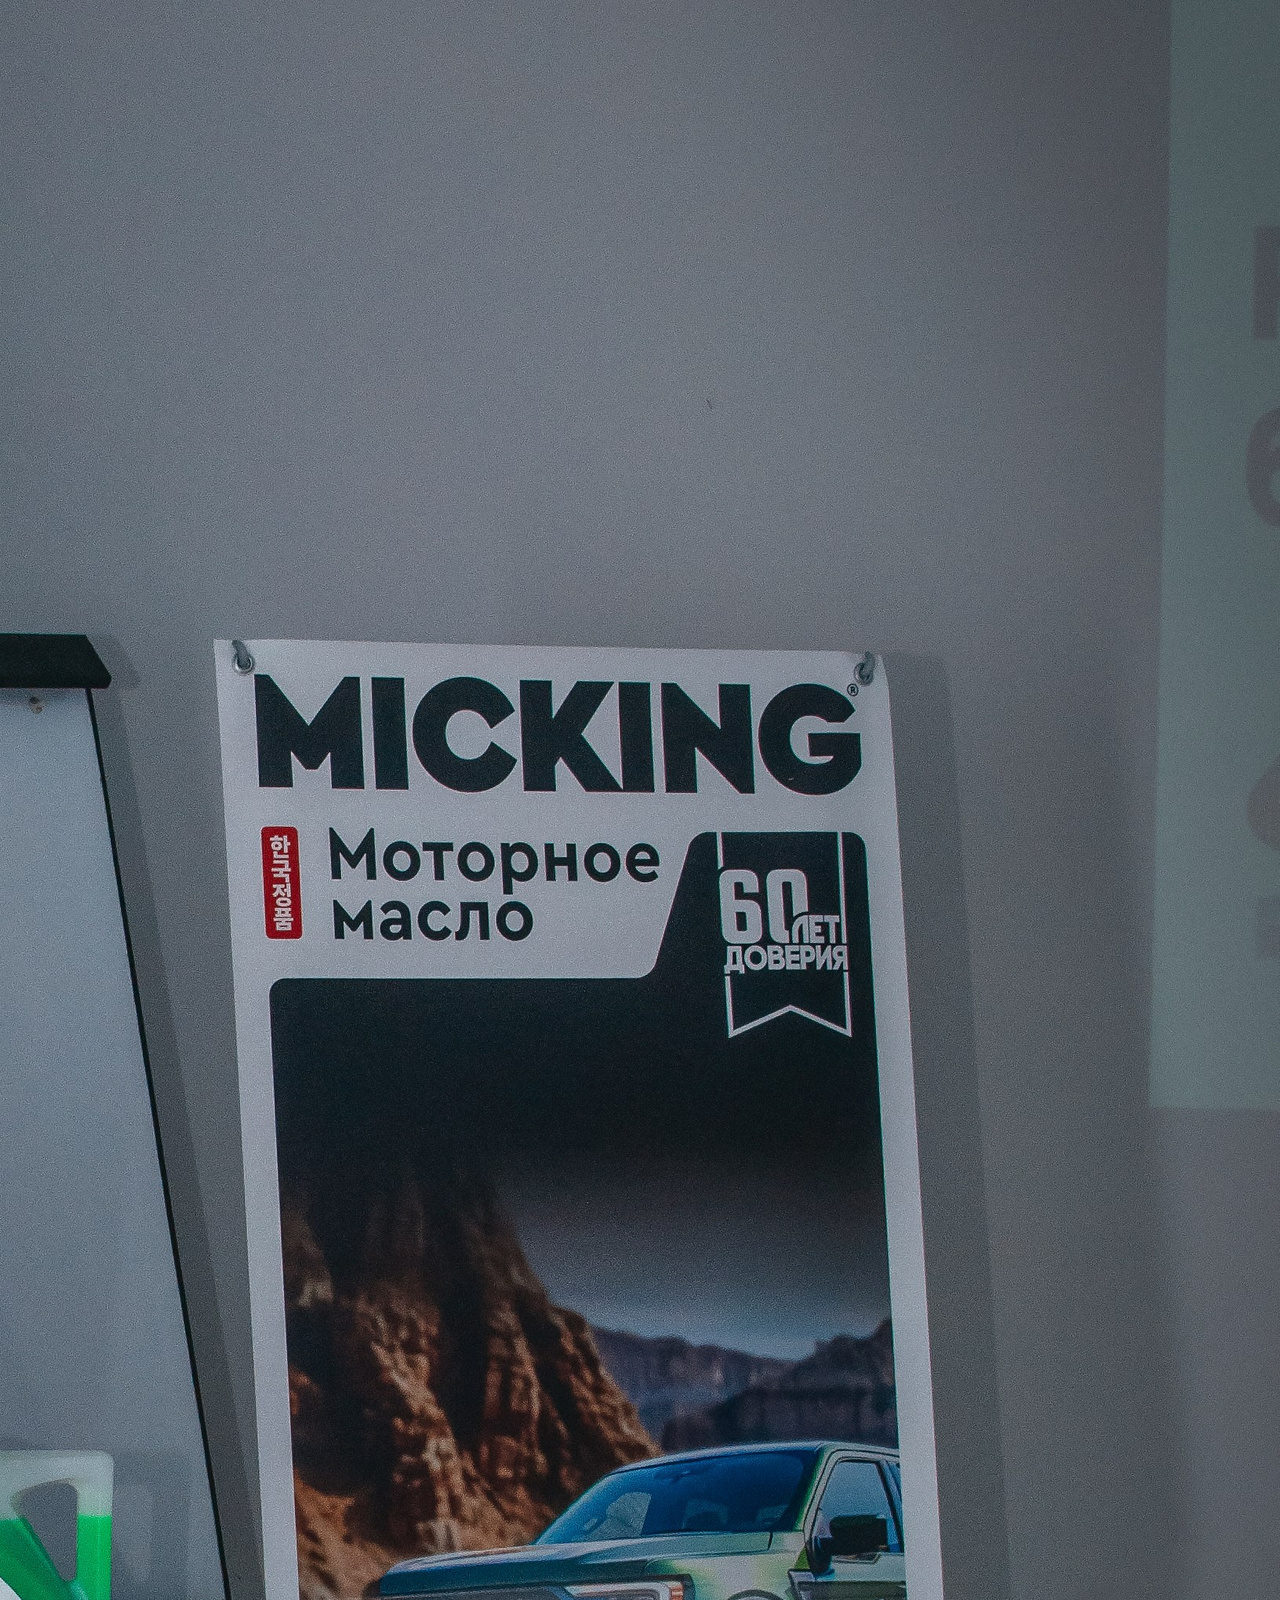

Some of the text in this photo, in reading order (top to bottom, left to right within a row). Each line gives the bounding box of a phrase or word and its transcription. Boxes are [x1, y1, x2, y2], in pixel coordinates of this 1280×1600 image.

[254, 674, 862, 796] MICKING
[268, 833, 293, 932] 한국정품
[329, 826, 660, 894] Моторное
[333, 900, 533, 942] масло
[719, 869, 841, 945] 60 ЛЕТ
[724, 944, 849, 974] ДОВЕРИЯ
